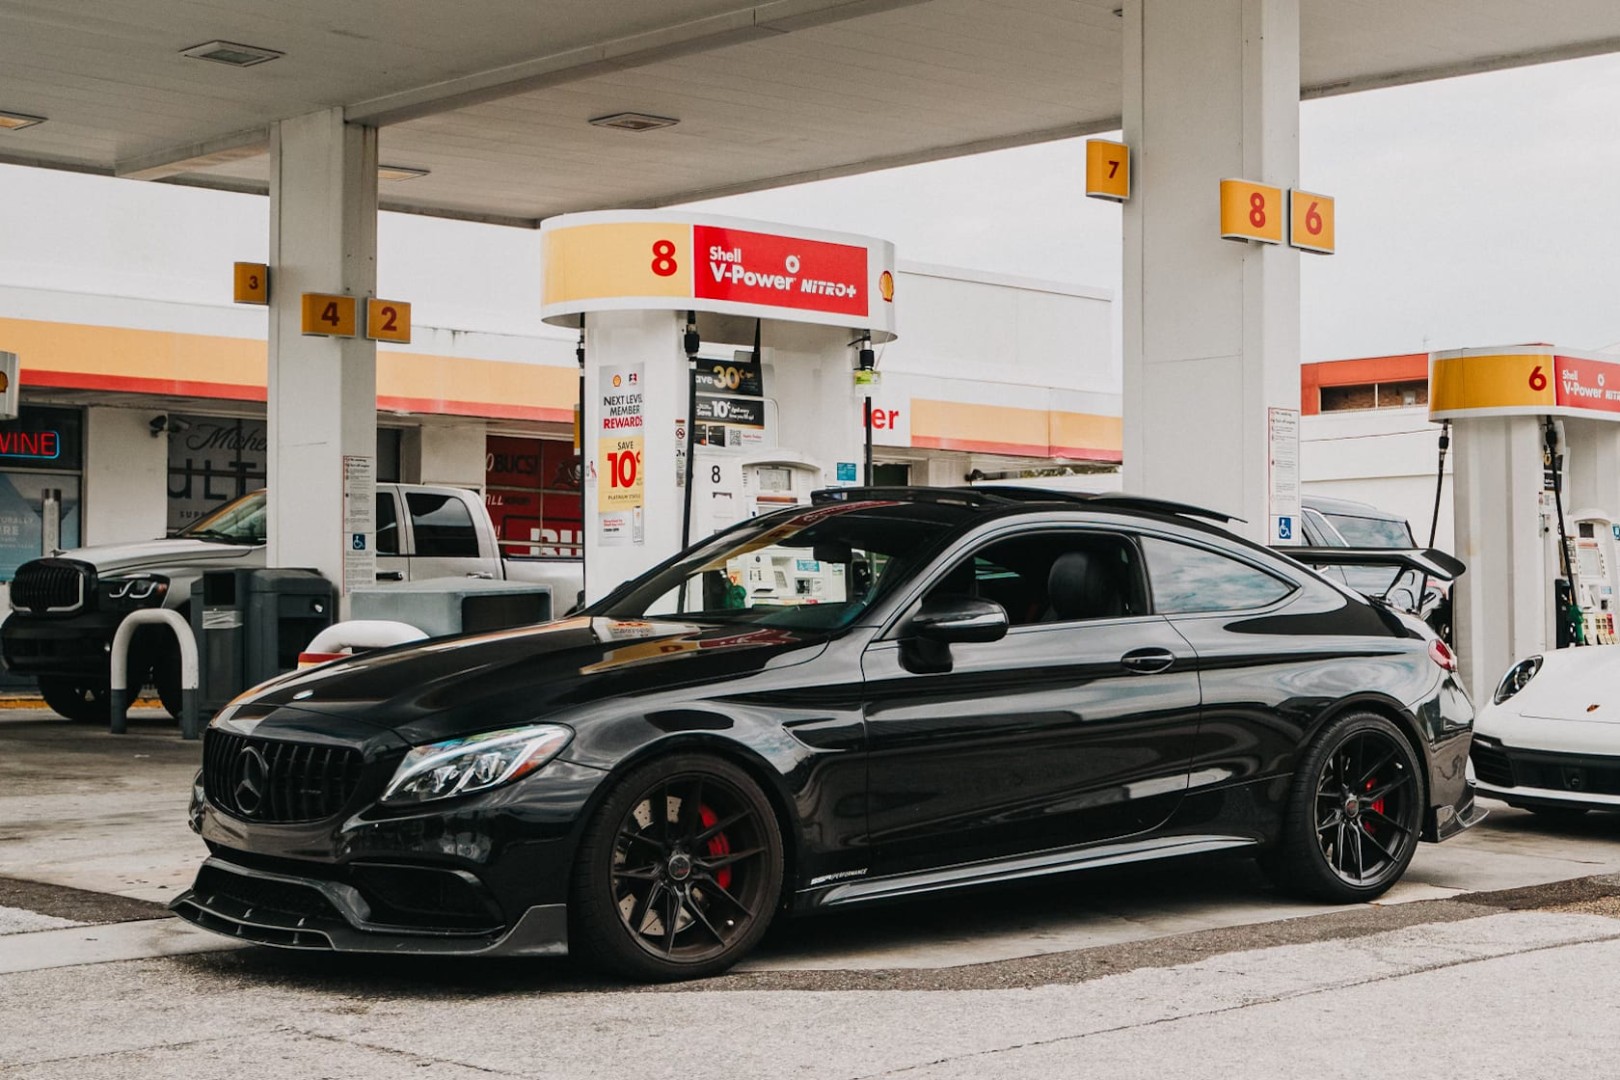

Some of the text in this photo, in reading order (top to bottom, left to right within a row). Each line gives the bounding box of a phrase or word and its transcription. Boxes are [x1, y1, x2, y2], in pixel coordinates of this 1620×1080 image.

[1108, 160, 1120, 179] 7
[1249, 192, 1266, 228] 8
[1305, 202, 1322, 235] 6
[651, 239, 678, 277] 8
[709, 246, 742, 263] Shell
[249, 276, 258, 290] 3
[709, 262, 794, 291] V-Power
[321, 302, 340, 326] 4
[381, 306, 397, 331] 2
[695, 375, 713, 385] ave
[1528, 366, 1547, 392] 6
[1563, 381, 1602, 399] V-Power
[603, 395, 625, 406] NEXT
[610, 404, 641, 417] MEMBER
[603, 415, 643, 430] REWARDS
[617, 440, 634, 450] SAVE
[711, 465, 721, 484] 8
